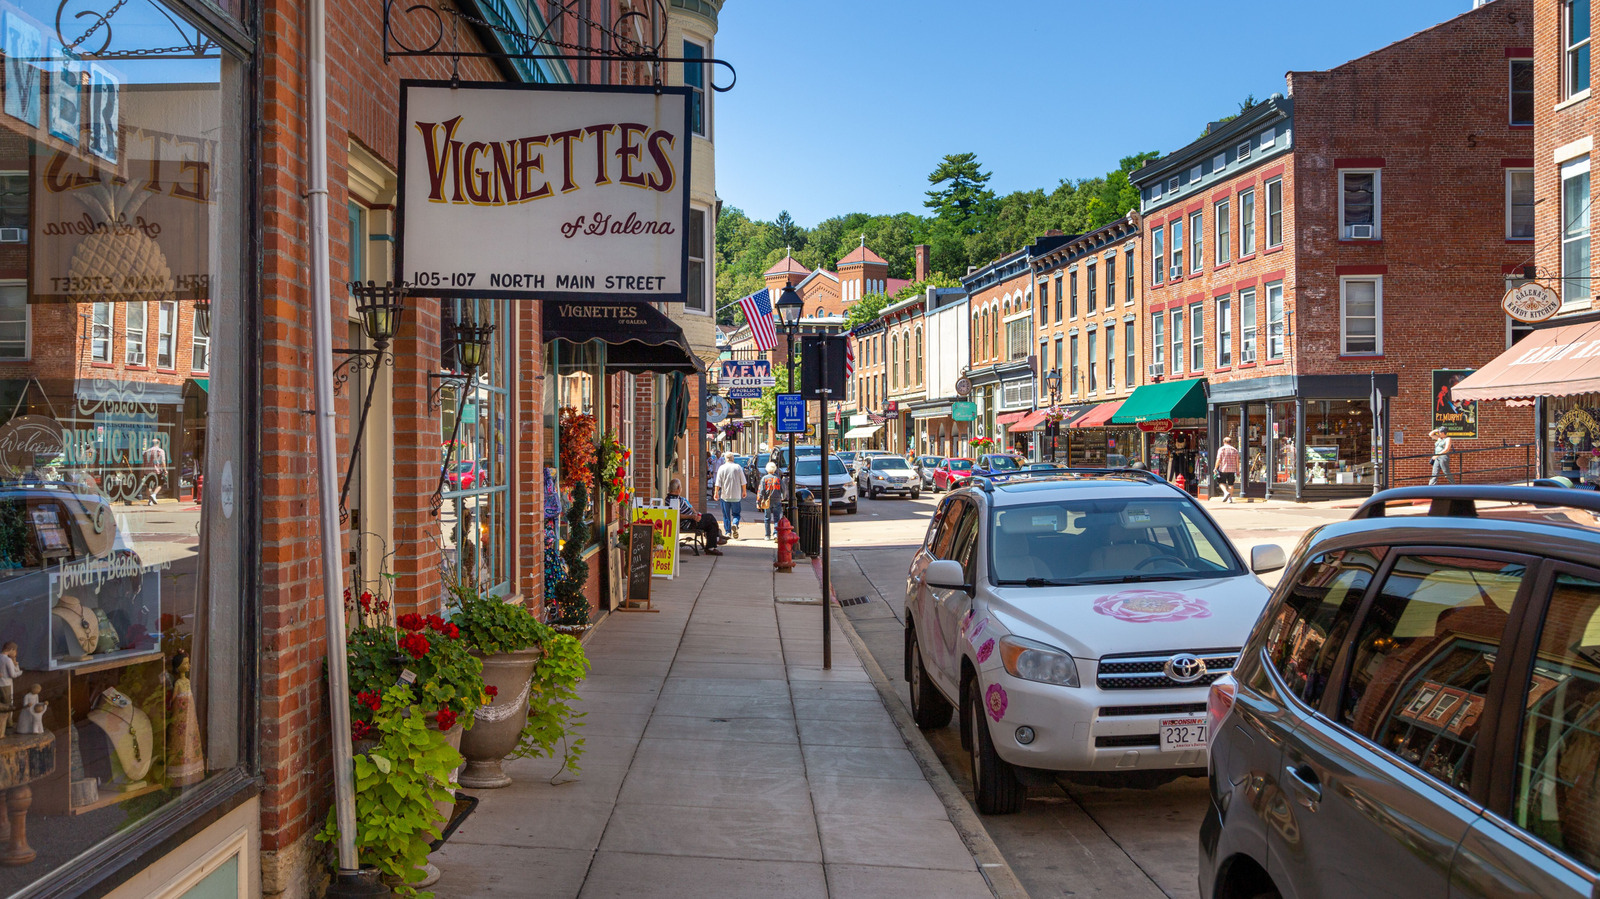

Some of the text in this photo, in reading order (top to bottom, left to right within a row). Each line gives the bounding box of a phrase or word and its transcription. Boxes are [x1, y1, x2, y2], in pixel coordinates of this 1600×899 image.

[414, 115, 676, 206] VIGNETTES
[561, 212, 676, 238] of Galena
[414, 271, 667, 291] 105-107 NORTH MAIN STREET
[1515, 289, 1548, 301] GALENA'S
[558, 303, 638, 318] VIGNETTES
[1507, 301, 1558, 319] KANDY KITCHEN
[0, 429, 63, 453] Welcom
[61, 428, 173, 466] RUSTIC RIVER
[57, 552, 105, 599] Jewelry,
[107, 549, 138, 581] Beads
[655, 560, 671, 571] Post
[1162, 718, 1197, 726] WISCONSIN
